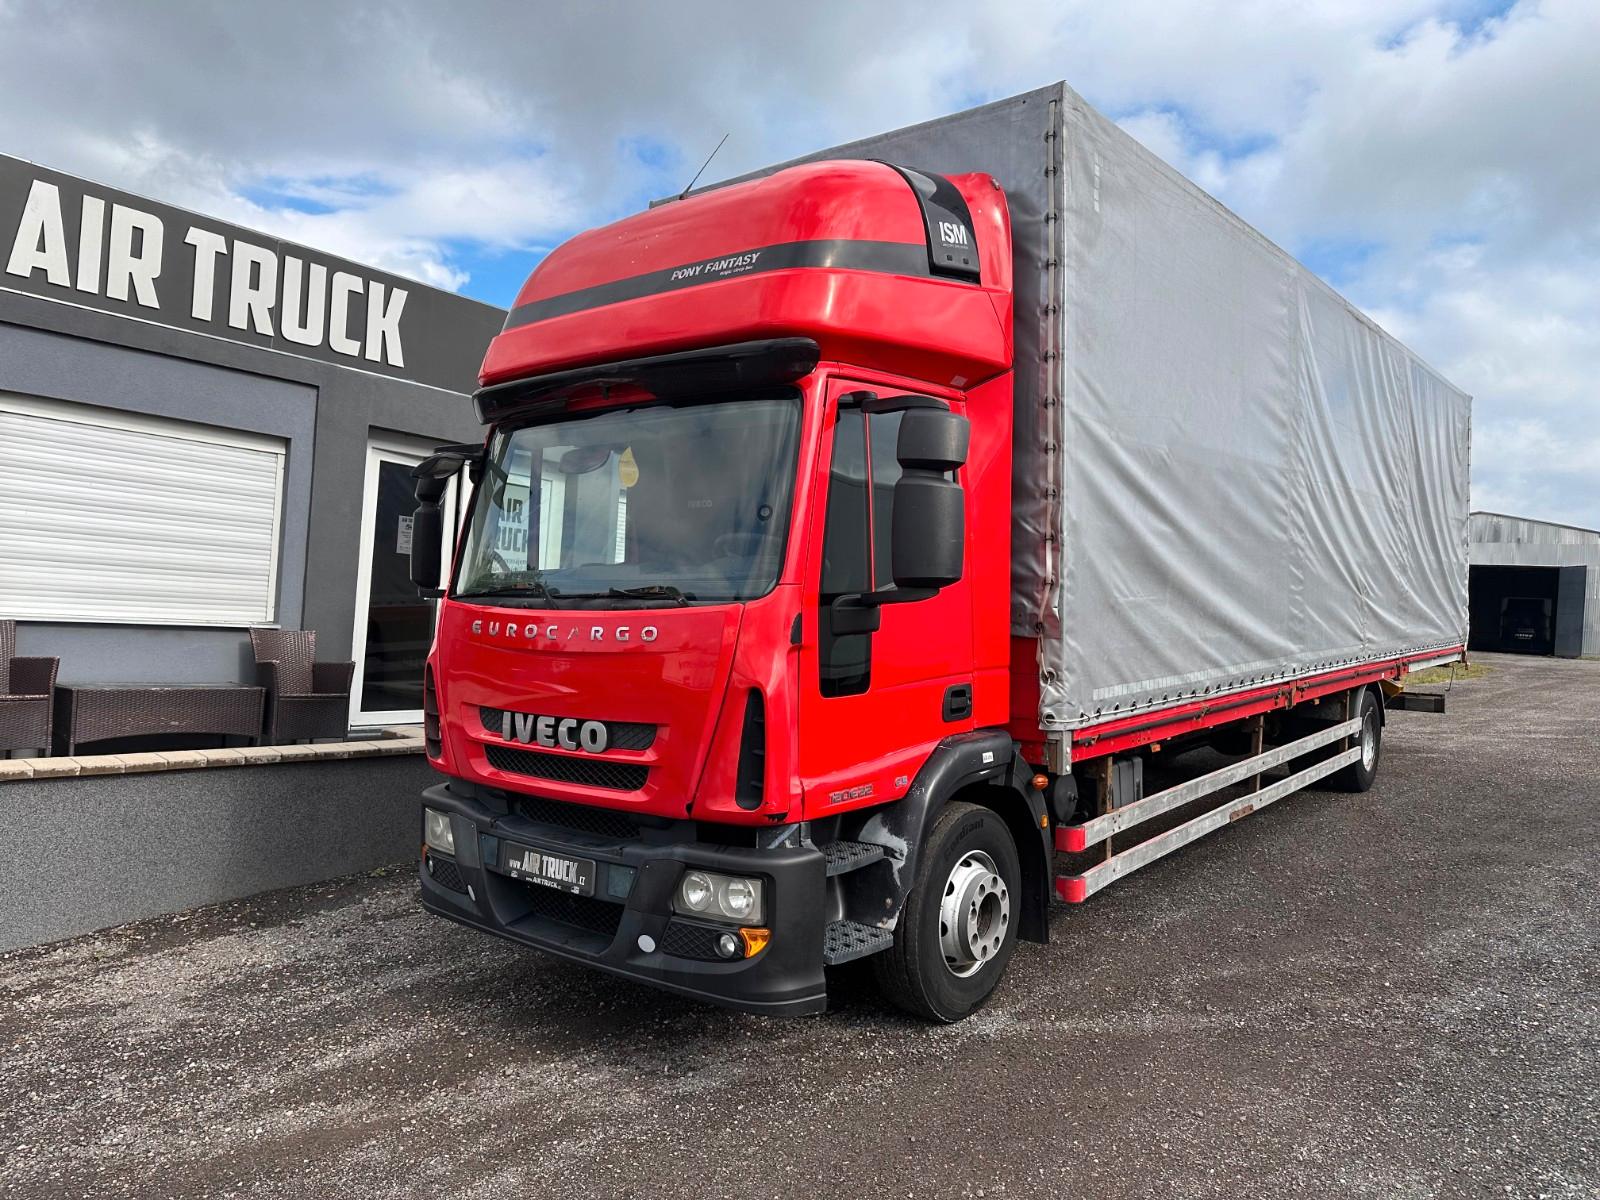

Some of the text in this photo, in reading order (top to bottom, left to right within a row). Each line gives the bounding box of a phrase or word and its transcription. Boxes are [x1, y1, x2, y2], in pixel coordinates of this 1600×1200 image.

[938, 221, 968, 245] ISM
[6, 178, 409, 368] AIR TRUCK
[670, 264, 703, 281] PONY
[704, 252, 761, 274] FANTASY
[502, 711, 608, 754] IVECO
